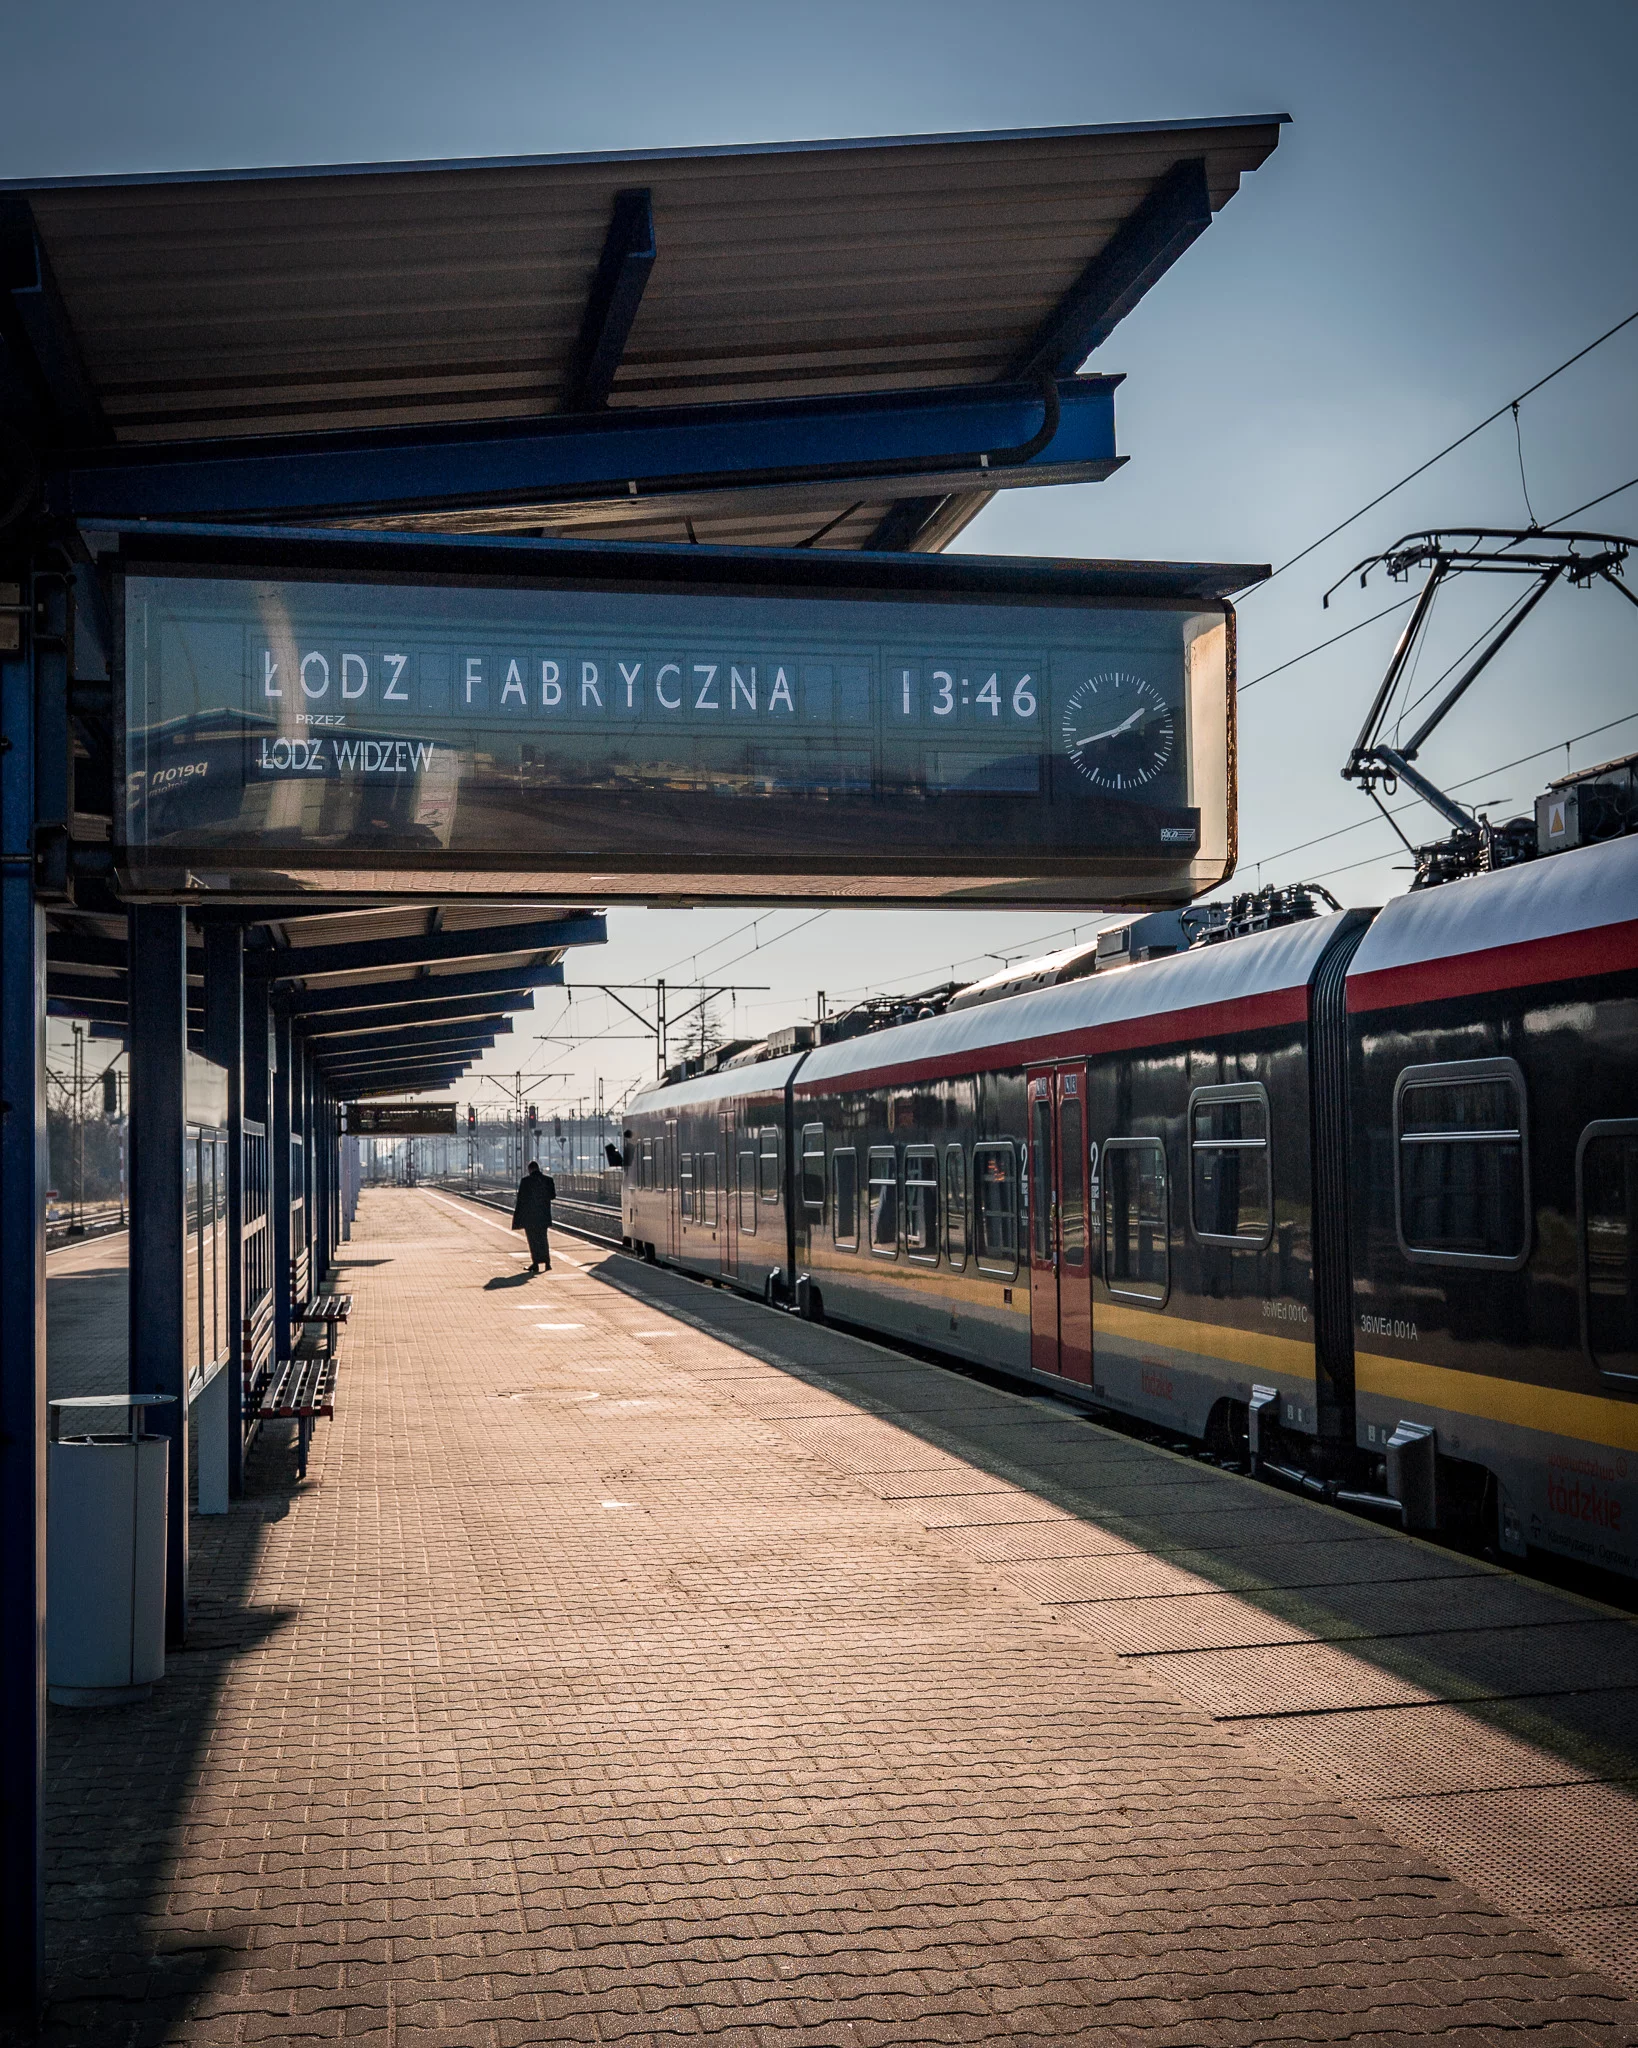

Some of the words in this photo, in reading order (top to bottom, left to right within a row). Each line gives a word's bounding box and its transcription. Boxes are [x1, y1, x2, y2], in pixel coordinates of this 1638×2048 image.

[264, 650, 409, 701] ŁÓDŹ
[465, 657, 795, 712] FABRYCZNA
[902, 669, 1038, 719] 13:46
[295, 713, 346, 726] PRZEZ
[262, 736, 323, 770] ŁÓDŹ
[333, 739, 435, 773] WIDZEW
[1021, 1143, 1028, 1181] 2
[1090, 1141, 1099, 1184] 2
[1261, 1300, 1287, 1320] 36WEd
[1288, 1304, 1308, 1324] 001C
[1360, 1314, 1392, 1337] 36WEd
[1394, 1319, 1418, 1342] 001A
